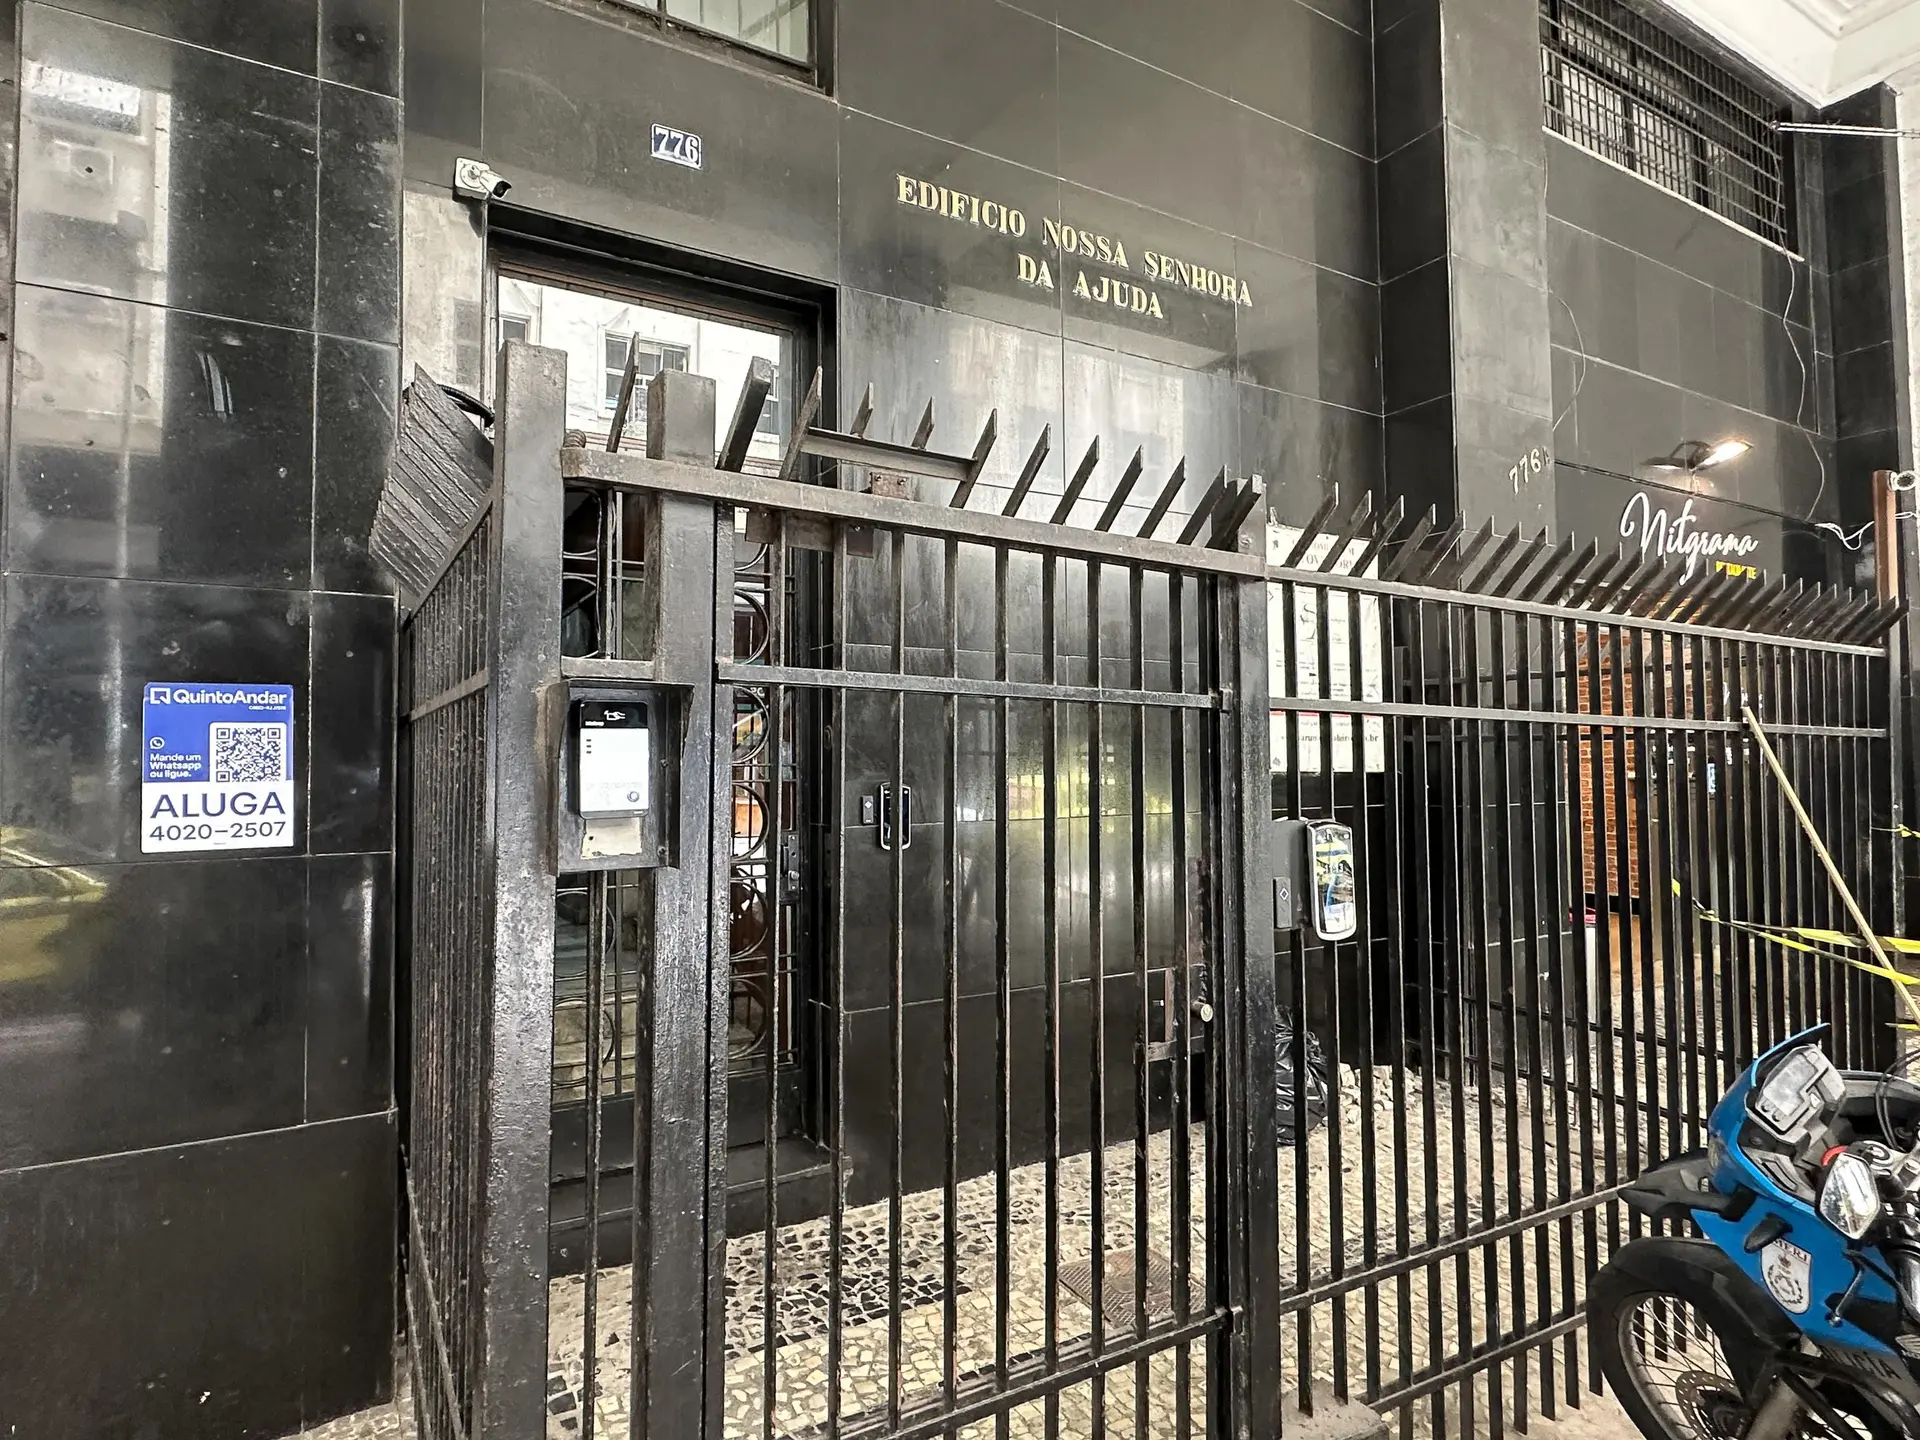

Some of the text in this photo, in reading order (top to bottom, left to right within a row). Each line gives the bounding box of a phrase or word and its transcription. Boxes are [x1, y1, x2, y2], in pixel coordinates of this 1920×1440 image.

[654, 126, 699, 163] 776
[896, 173, 1253, 308] EDIFICIO NOSSA SENHORA
[1017, 252, 1164, 320] DA AJUDA
[1620, 492, 1759, 586] Nitgrama
[173, 690, 287, 705] QuintoAndar
[150, 753, 185, 762] Mande
[150, 762, 202, 771] Whatsapp
[165, 769, 192, 780] ligue.
[150, 792, 286, 819] ALUGA
[149, 821, 286, 841] 4020-2507
